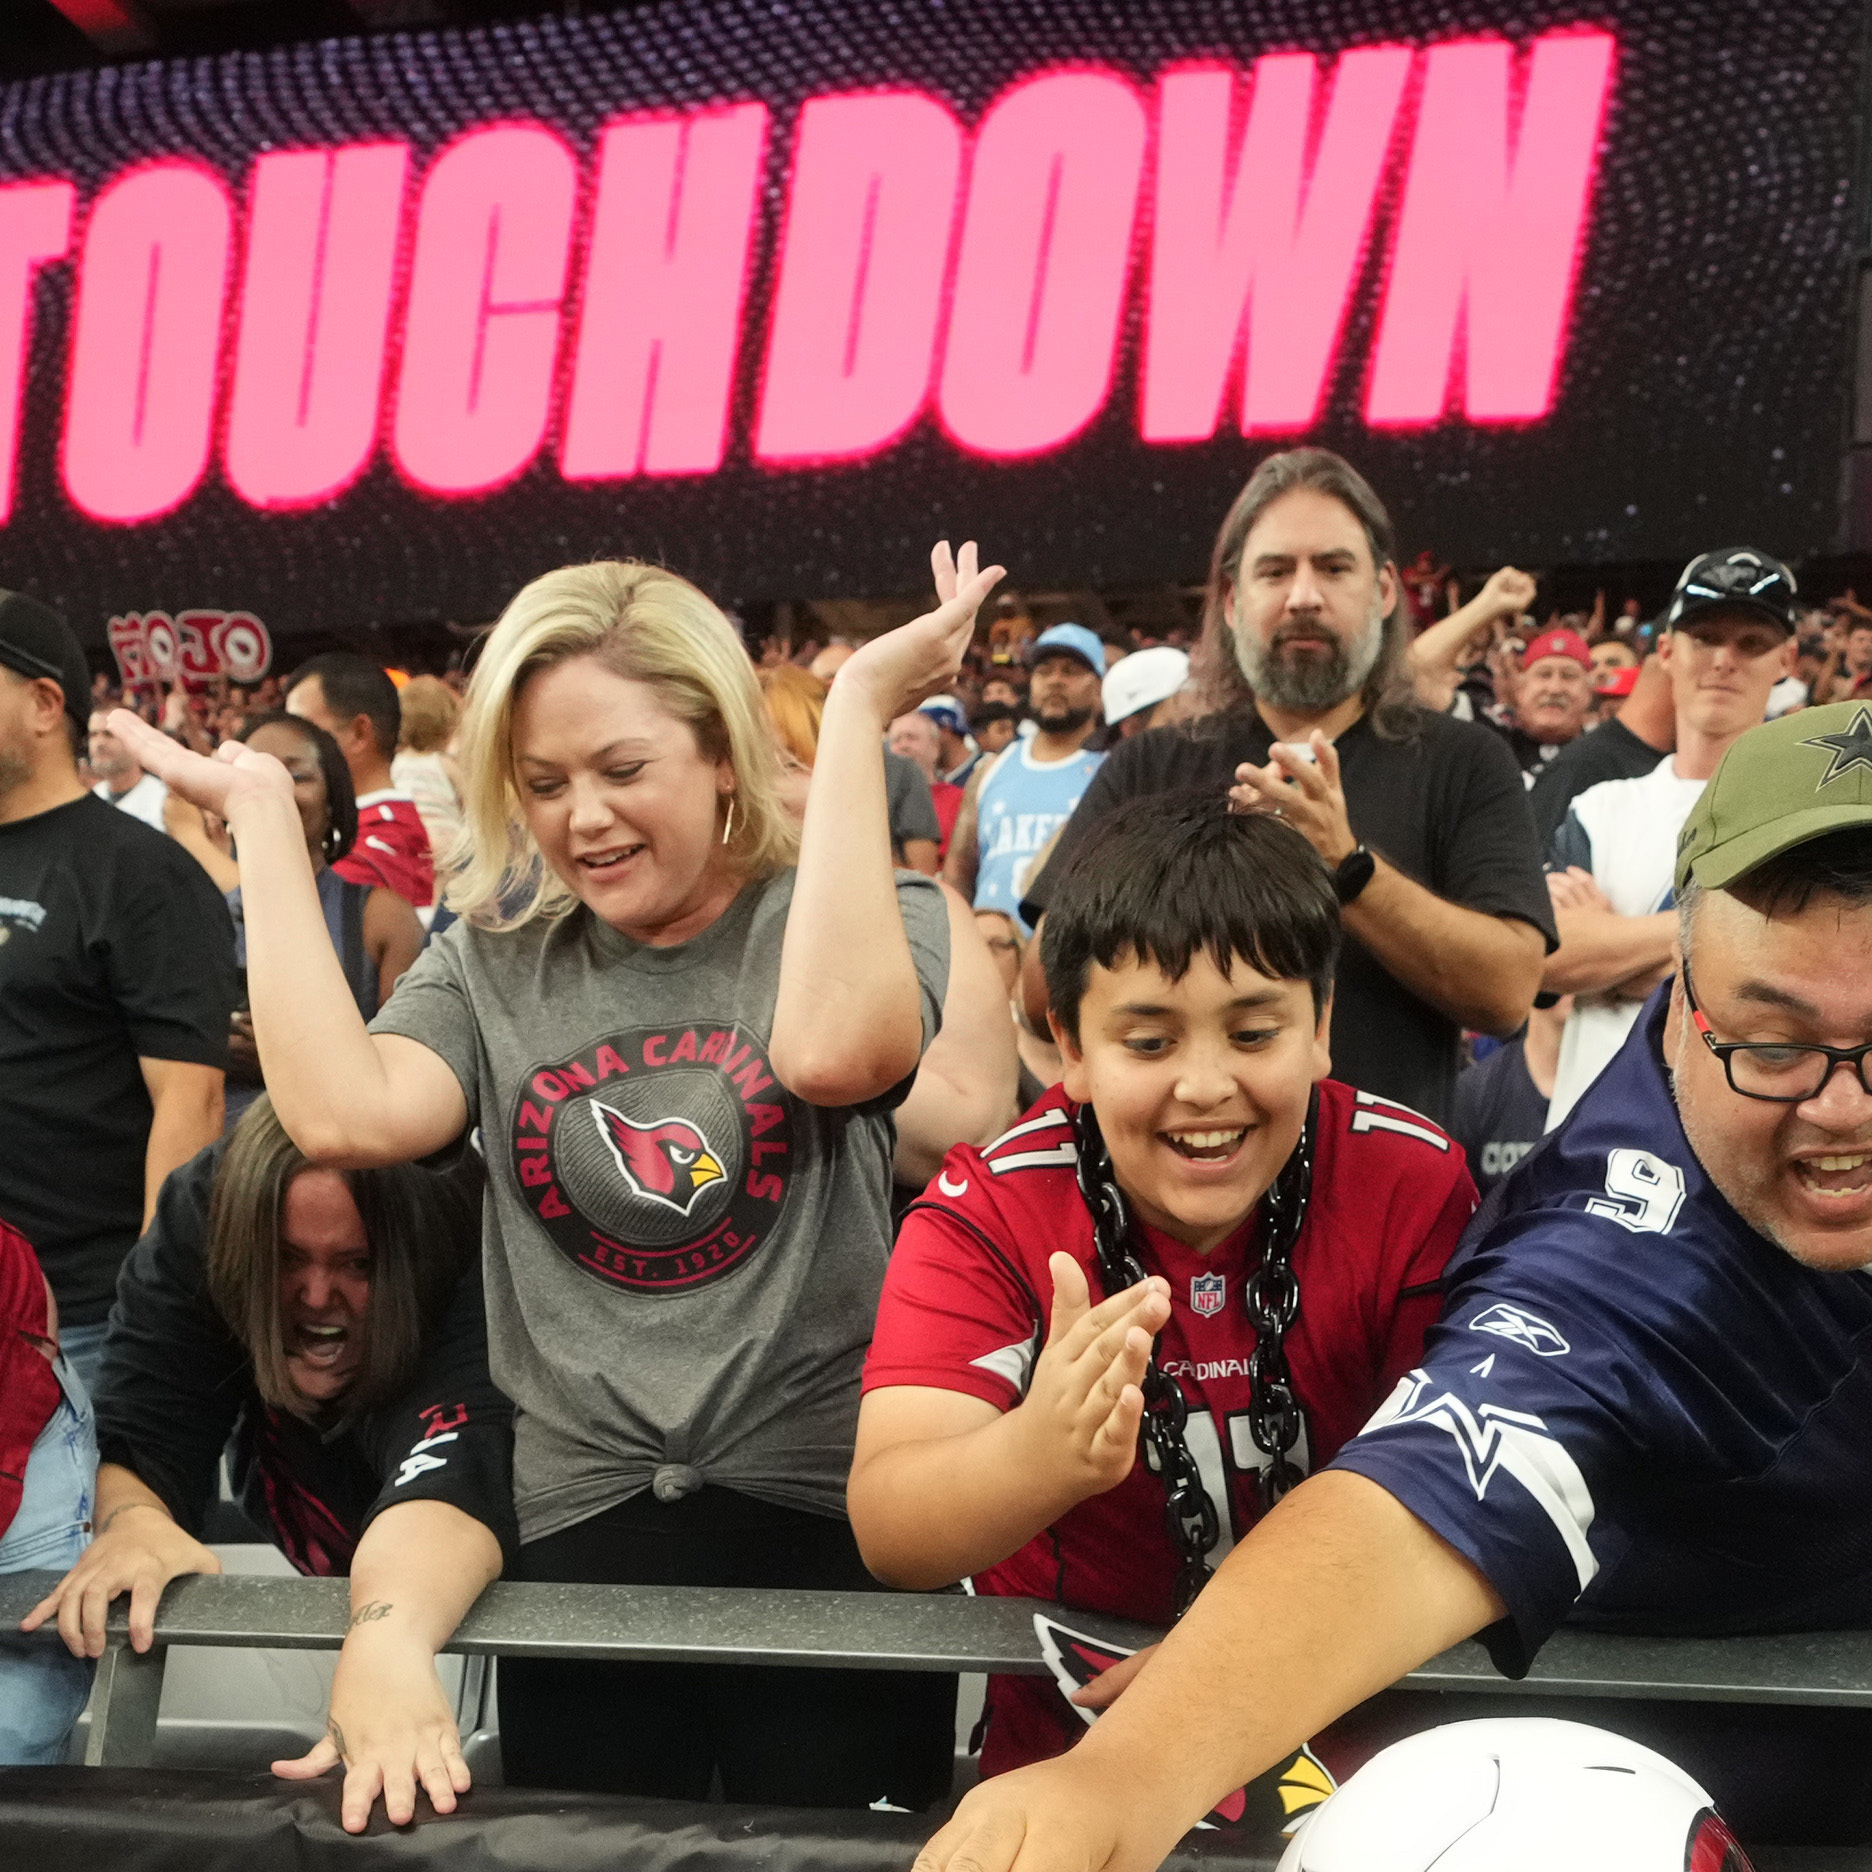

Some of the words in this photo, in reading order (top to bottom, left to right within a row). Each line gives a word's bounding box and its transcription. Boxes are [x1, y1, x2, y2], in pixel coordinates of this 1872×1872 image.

[516, 1043, 631, 1221] ARIZONA
[641, 1028, 790, 1203] CARDINALS
[593, 1244, 662, 1280] EST.
[674, 1229, 742, 1278] 1920
